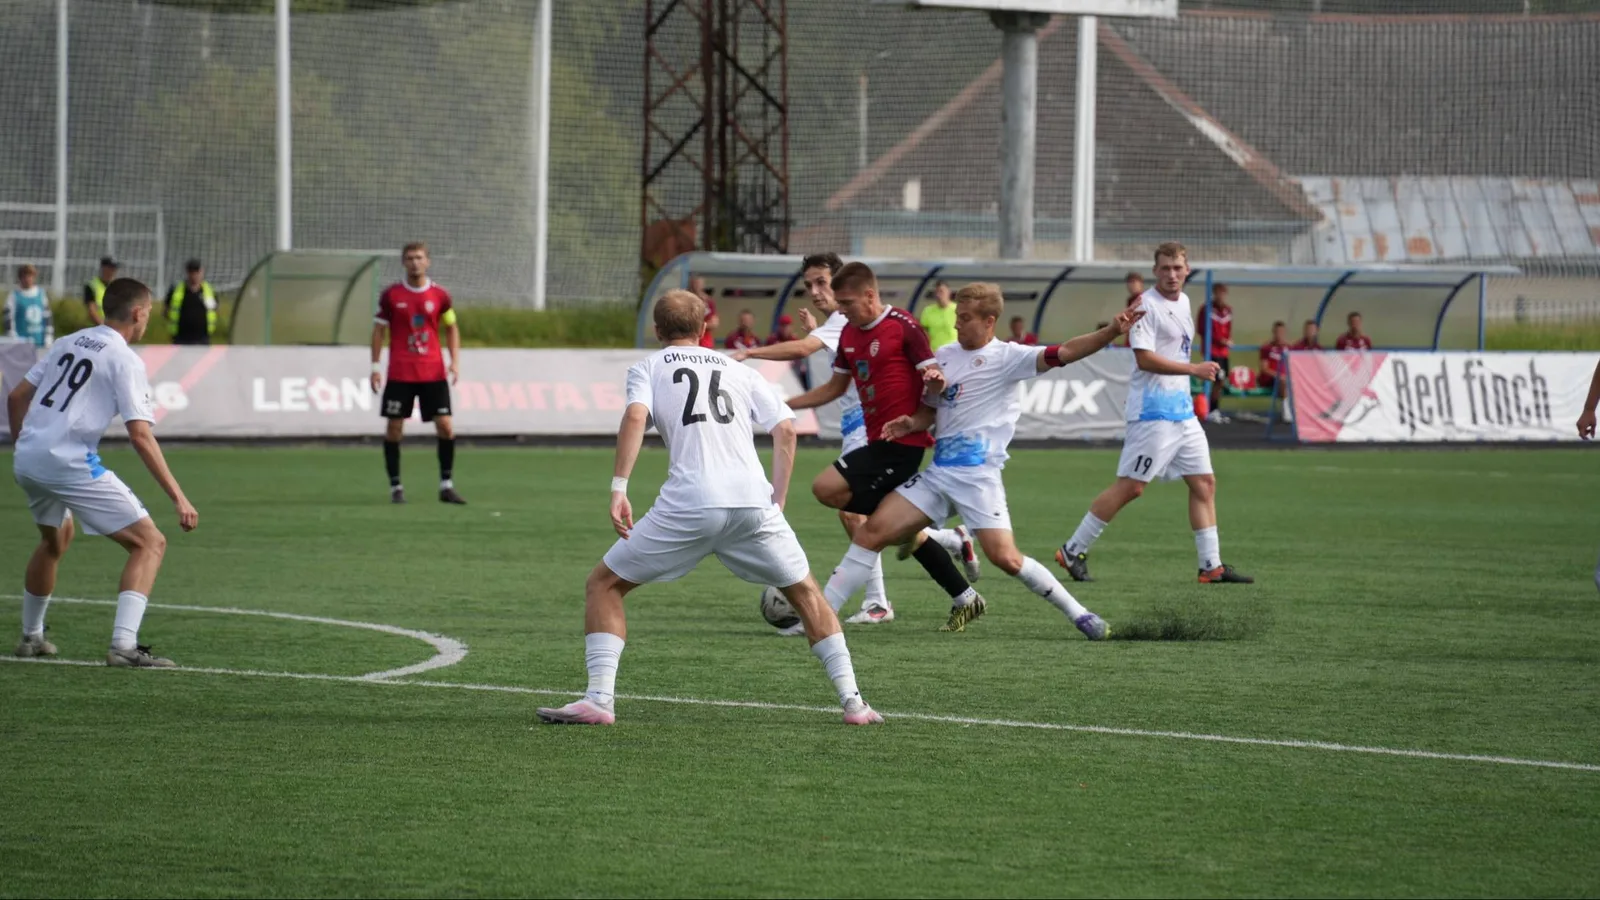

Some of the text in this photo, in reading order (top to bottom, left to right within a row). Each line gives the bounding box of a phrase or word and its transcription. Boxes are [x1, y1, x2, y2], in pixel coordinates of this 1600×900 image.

[40, 353, 93, 412] 29
[663, 352, 728, 367] СИРОТКОВ
[252, 377, 371, 412] LEON
[673, 367, 735, 426] 26
[1391, 356, 1552, 435] Red finch
[1134, 454, 1153, 475] 19
